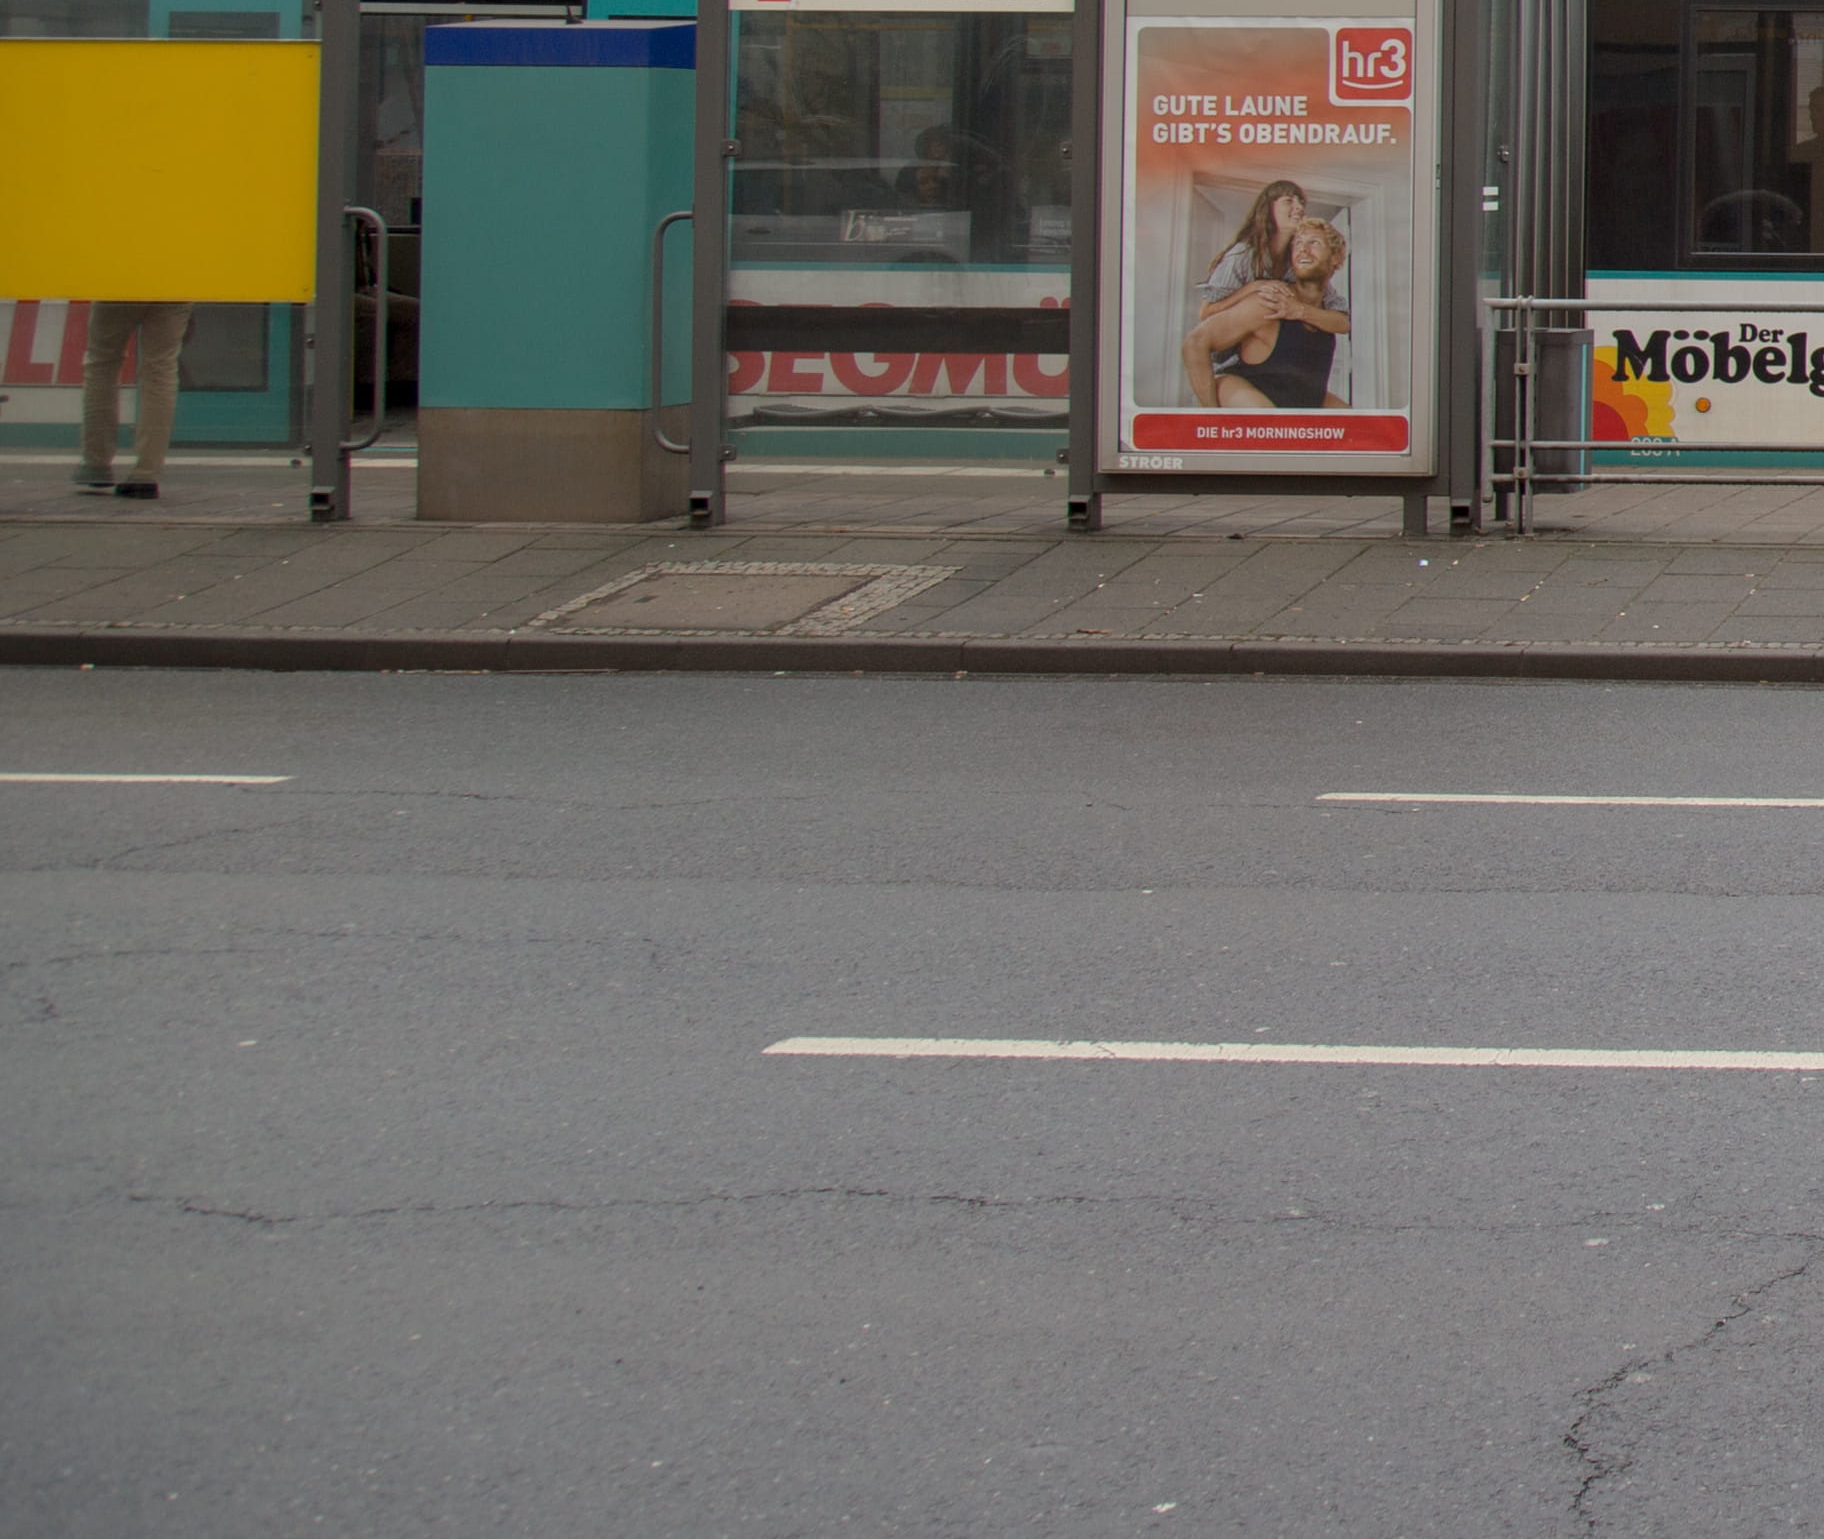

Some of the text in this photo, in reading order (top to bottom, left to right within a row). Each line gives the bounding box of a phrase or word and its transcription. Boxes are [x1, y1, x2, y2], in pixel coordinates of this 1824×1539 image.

[1342, 39, 1407, 79] hr3
[1153, 95, 1308, 117] GUTE LAUNE
[1153, 123, 1397, 145] GIBT’S OBENDRAUF.
[1739, 323, 1783, 343] Der
[1196, 427, 1345, 440] DIE hr3 MORNINGSHOW
[1118, 454, 1183, 470] STRÖER
